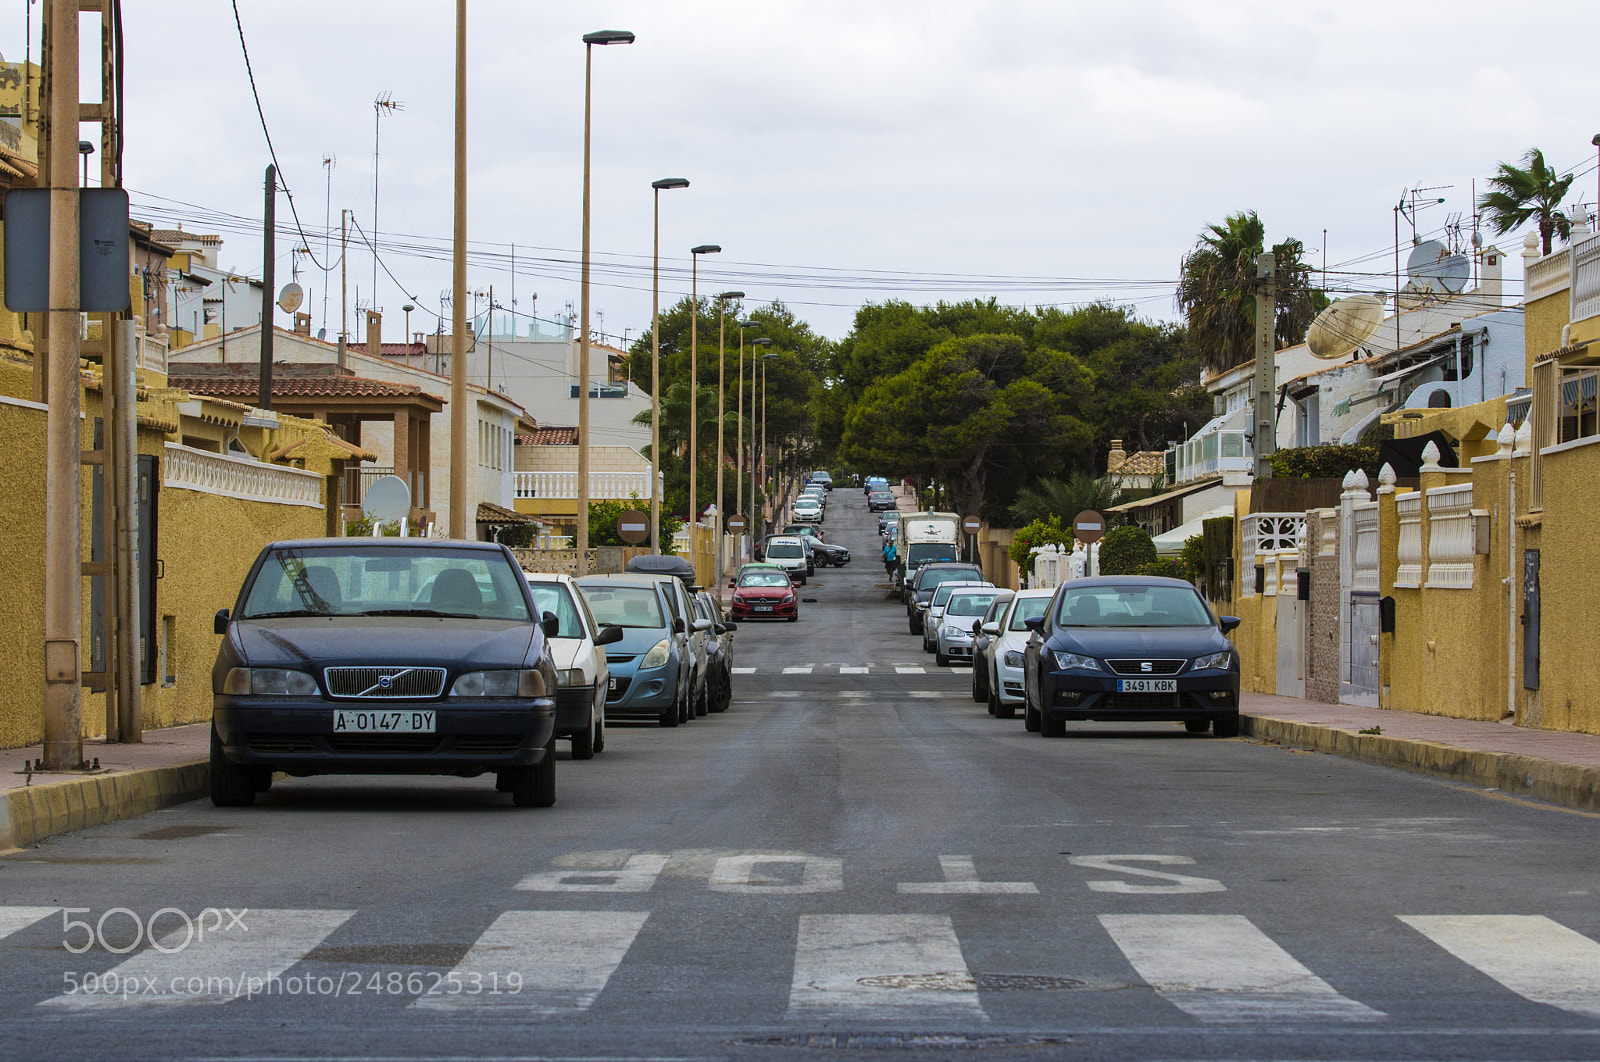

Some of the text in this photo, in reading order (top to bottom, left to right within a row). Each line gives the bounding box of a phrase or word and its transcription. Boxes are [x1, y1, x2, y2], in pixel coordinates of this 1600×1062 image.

[1125, 681, 1150, 691] 3491
[1154, 681, 1174, 691] KBK
[512, 850, 1228, 894] STOP
